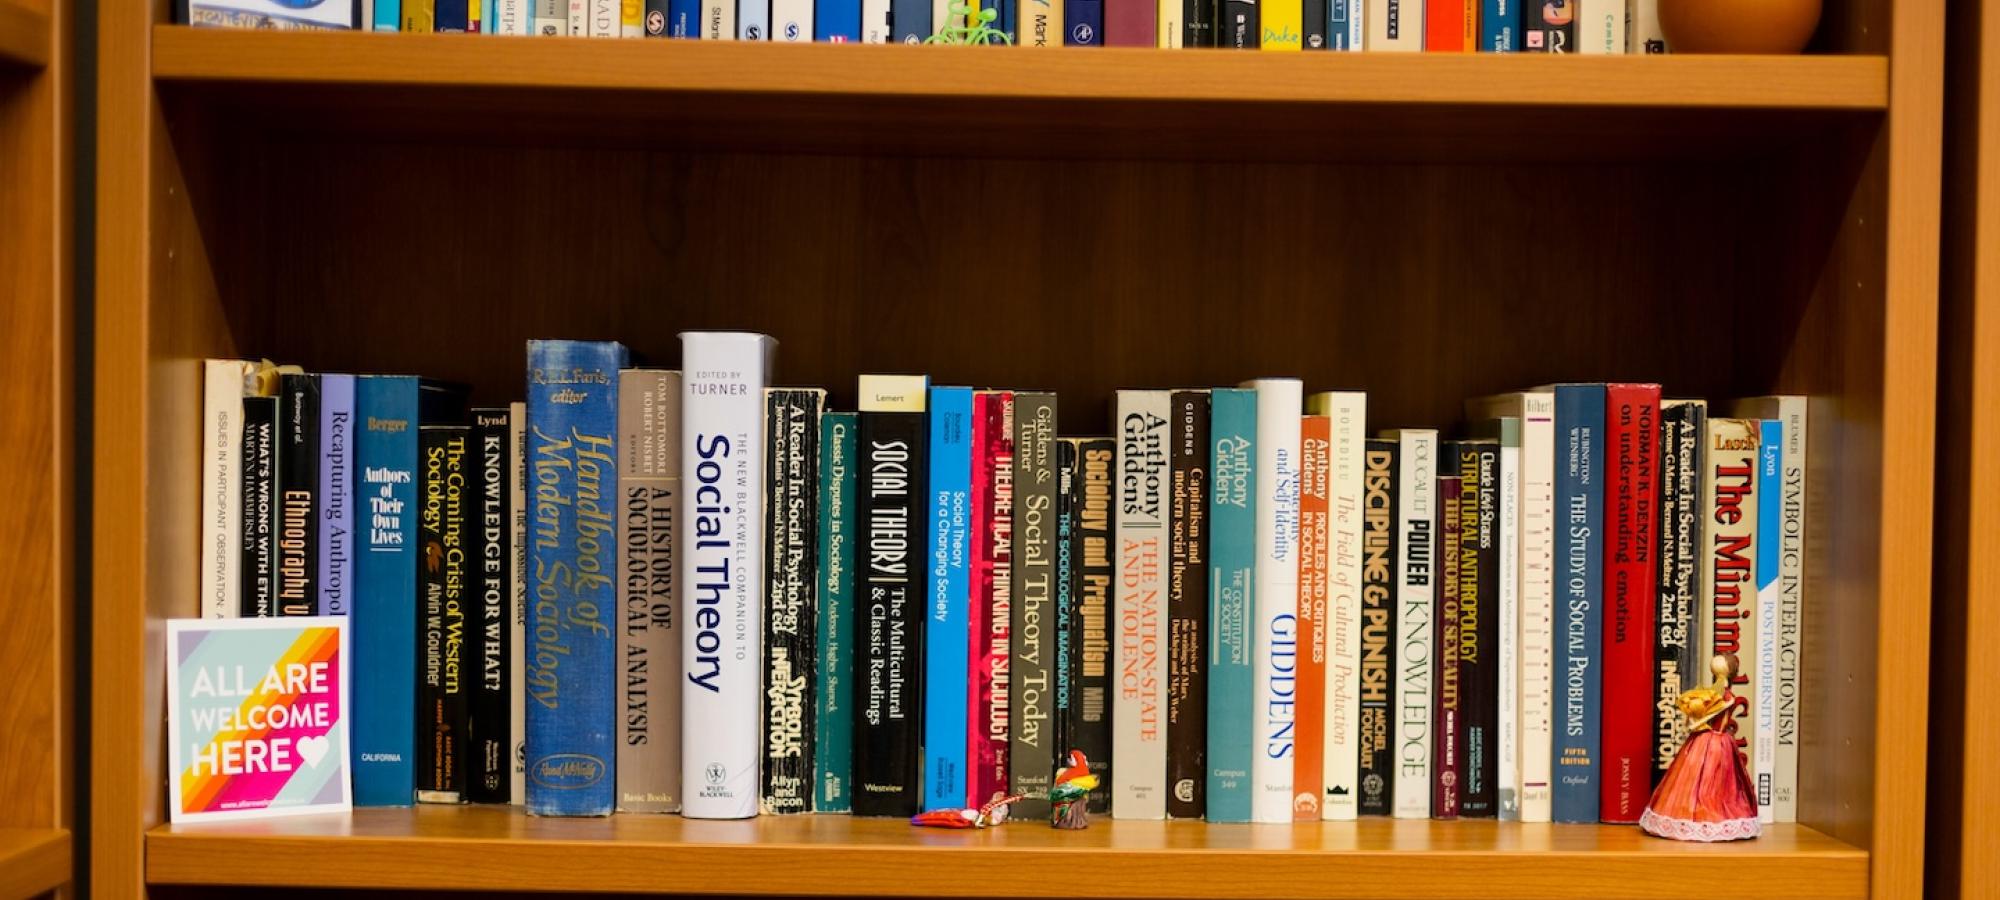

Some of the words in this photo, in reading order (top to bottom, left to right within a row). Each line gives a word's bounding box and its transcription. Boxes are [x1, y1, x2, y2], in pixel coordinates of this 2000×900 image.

[1034, 13, 1048, 47] Mark
[1263, 28, 1299, 44] Duke
[551, 389, 588, 405] editor
[656, 376, 668, 402] TOM
[690, 383, 748, 396] TURNER
[696, 371, 727, 379] EDITED
[730, 371, 741, 379] BY
[875, 394, 904, 403] Lemert
[367, 417, 408, 432] Berger
[477, 415, 507, 427] Lynd
[643, 391, 654, 432] ROBERT
[1036, 405, 1052, 466] Giddens
[1184, 402, 1194, 456] GIDDENS
[1620, 404, 1632, 425] on
[1790, 414, 1799, 455] BLUMER
[245, 423, 256, 473] MARTYN
[258, 423, 270, 477] WHAT'S
[325, 411, 348, 520] Recapturing
[447, 436, 465, 471] The
[643, 435, 654, 474] NISBET
[656, 404, 668, 475] BOTTOMORE
[736, 432, 748, 456] THE
[1021, 418, 1036, 473] Turner
[1123, 412, 1145, 515] Giddens
[1276, 449, 1291, 478] and
[1338, 407, 1350, 482] BOURDIEU
[1764, 445, 1778, 476] Lyon
[364, 467, 411, 483] Authors
[424, 447, 446, 534] Sociology
[533, 425, 573, 553] Modern
[696, 433, 731, 551] Social
[736, 460, 748, 488] NEW
[871, 440, 909, 499] SOCIAL
[1035, 468, 1051, 485] &
[1060, 467, 1072, 495] Mills
[1081, 449, 1112, 531] Sociology
[1138, 412, 1167, 520] Anthony
[1215, 439, 1234, 505] Giddens
[1231, 435, 1251, 508] Anthony
[1303, 438, 1316, 496] Giddens
[1314, 439, 1329, 501] Anthony
[1413, 439, 1429, 515] FOUCAULT
[1714, 457, 1753, 525] The
[244, 476, 256, 551] HAMMERSLEY
[258, 480, 269, 533] WRONG
[370, 498, 404, 514] Their
[443, 473, 465, 547] Coming
[485, 436, 501, 573] KNOWLEDGE
[572, 425, 616, 597] Handbook
[653, 487, 672, 500] A
[953, 490, 965, 528] Social
[1174, 470, 1188, 518] modern
[1188, 467, 1204, 538] Capitalism
[1337, 493, 1355, 525] The
[1364, 450, 1392, 584] DISCIPLINE
[1446, 497, 1460, 530] THE
[1461, 452, 1479, 546] STRUCTURAL
[1570, 493, 1588, 524] THE
[1615, 432, 1635, 564] understanding
[1783, 467, 1800, 569] SYMBOLIC
[371, 530, 403, 544] Lives
[372, 514, 400, 530] Own
[736, 491, 747, 562] BLACKWELL
[870, 506, 908, 575] THEORY
[1024, 494, 1050, 568] Social
[1059, 512, 1071, 536] THE
[1173, 520, 1187, 558] social
[1272, 479, 1291, 563] Self-Identity
[1314, 511, 1326, 572] PROFILES
[257, 536, 269, 574] WITH
[446, 548, 464, 598] Crisis
[627, 487, 649, 637] SOCIOLOGICAL
[651, 506, 672, 601] HISTORY
[951, 529, 965, 569] Theory
[1084, 536, 1110, 567] and
[1123, 538, 1140, 588] AND
[1142, 536, 1158, 584] THE
[1188, 541, 1201, 564] and
[1336, 528, 1354, 568] Field
[1406, 519, 1430, 587] POWER
[1444, 532, 1459, 598] HISTORY
[1569, 526, 1590, 577] STUDY
[484, 579, 500, 619] FOR
[735, 567, 747, 641] COMPANION
[871, 587, 886, 600] &
[891, 587, 906, 616] The
[1058, 540, 1070, 628] SOCIOLOGICAL
[1170, 561, 1186, 601] theory
[1313, 573, 1325, 598] AND
[1330, 570, 1353, 590] of
[1363, 586, 1390, 608] &
[1568, 577, 1586, 597] OF
[446, 600, 464, 620] of
[528, 555, 572, 709] Sociology
[567, 601, 610, 640] of
[651, 603, 672, 630] OF
[688, 557, 731, 694] Theory
[828, 601, 839, 638] Anderson
[870, 603, 886, 655] Classic
[1019, 573, 1050, 665] Theory
[1078, 575, 1110, 677] Pragmatism
[1312, 600, 1325, 664] CRITIQUES
[1334, 593, 1353, 658] Cultural
[1443, 601, 1458, 624] OF
[1460, 549, 1479, 664] ANTHROPOLOGY
[1568, 599, 1590, 654] SOCIAL
[1616, 571, 1632, 644] emotion
[1713, 533, 1752, 684] Miniml
[445, 621, 463, 693] Western
[484, 622, 500, 691] WHAT?
[735, 645, 746, 661] TO
[825, 642, 838, 672] Hughes
[889, 620, 905, 720] Multicultural
[1057, 633, 1069, 709] IMAGINATION
[1122, 592, 1139, 701] VIOLENCE
[1141, 589, 1158, 742] NATION-STATE
[1361, 609, 1389, 701] PUNISH
[1443, 625, 1458, 710] SEXUALITY
[1760, 601, 1775, 731] POSTMODERNITY
[1778, 574, 1798, 746] INTERACTIONISM
[190, 665, 254, 698] ALL
[260, 662, 329, 695] ARE
[627, 644, 648, 748] ANALYSIS
[827, 676, 838, 712] Sharrock
[865, 658, 886, 726] Readings
[1267, 614, 1296, 759] GIDDENS
[1333, 664, 1353, 746] Production
[1402, 600, 1429, 778] KNOWLEDGE
[1567, 656, 1589, 736] PROBLEMS
[191, 703, 329, 732] WELCOME
[1018, 668, 1048, 748] Today
[1374, 708, 1387, 751] MICHEL
[191, 738, 292, 777] HERE
[361, 753, 402, 761] CALIFORNIA
[1361, 708, 1374, 769] FOUCAULT
[623, 793, 645, 802] Basic
[646, 793, 673, 802] Books
[770, 775, 801, 787] Allyn
[1017, 775, 1048, 785] Stanford
[1214, 769, 1246, 778] Campus
[1562, 775, 1589, 785] Oxford
[767, 797, 803, 807] Bacon
